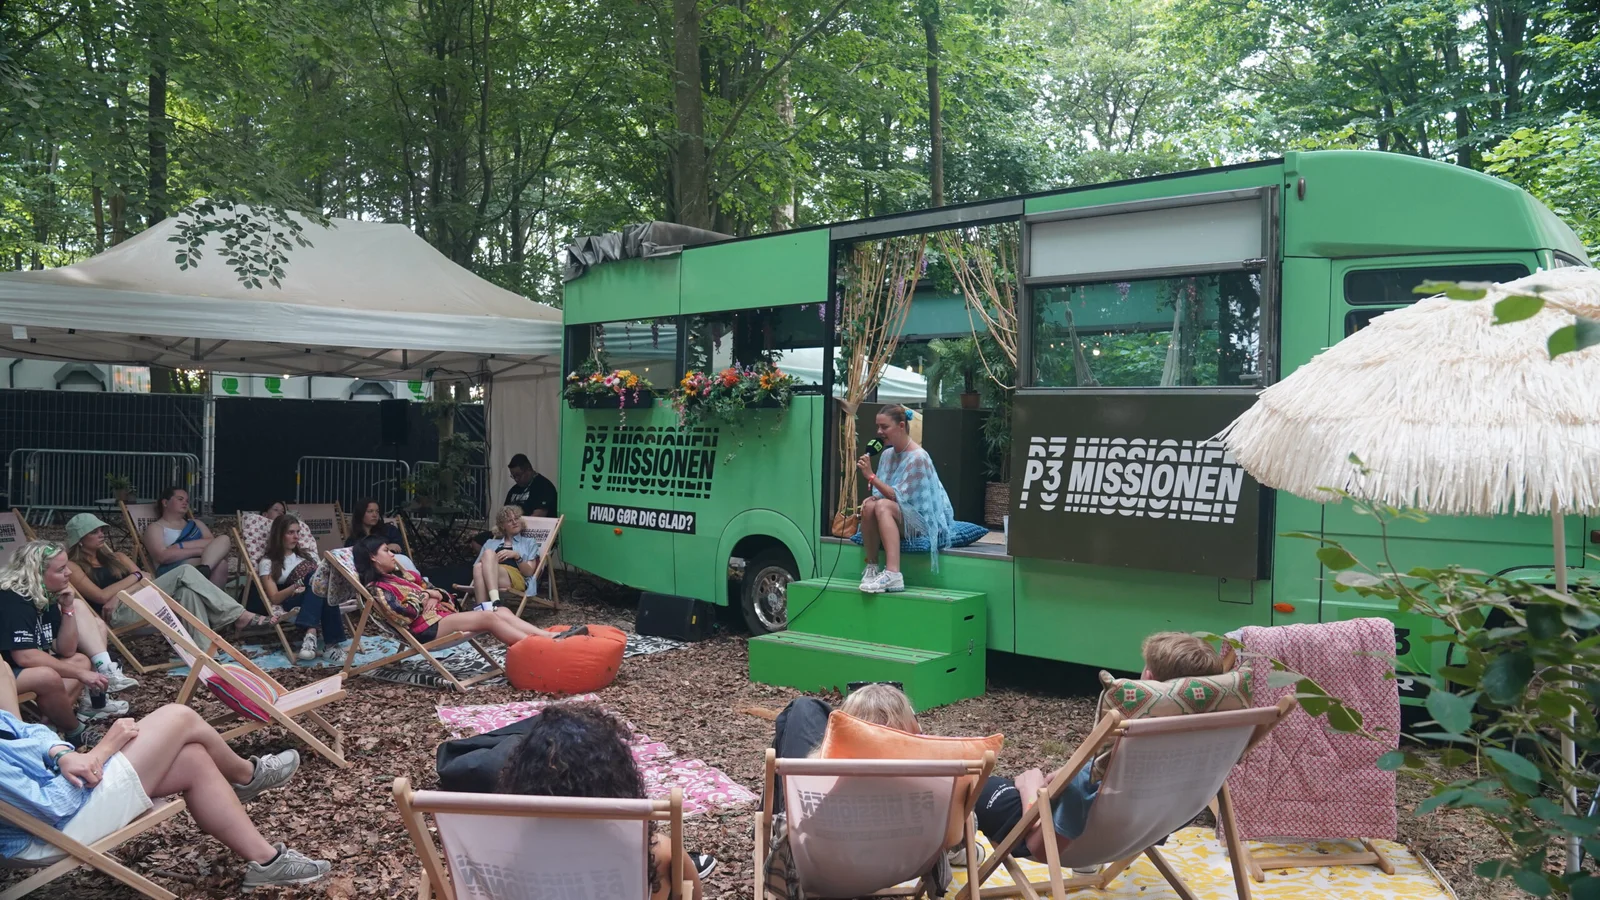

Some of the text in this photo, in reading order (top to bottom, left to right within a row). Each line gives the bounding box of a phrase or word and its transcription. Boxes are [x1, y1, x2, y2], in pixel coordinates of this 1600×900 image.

[582, 446, 716, 480] P3 MISSIONEN
[1023, 460, 1245, 502] P3 MISSIONEN
[590, 506, 693, 531] HVAD GØR DIG GLAD?
